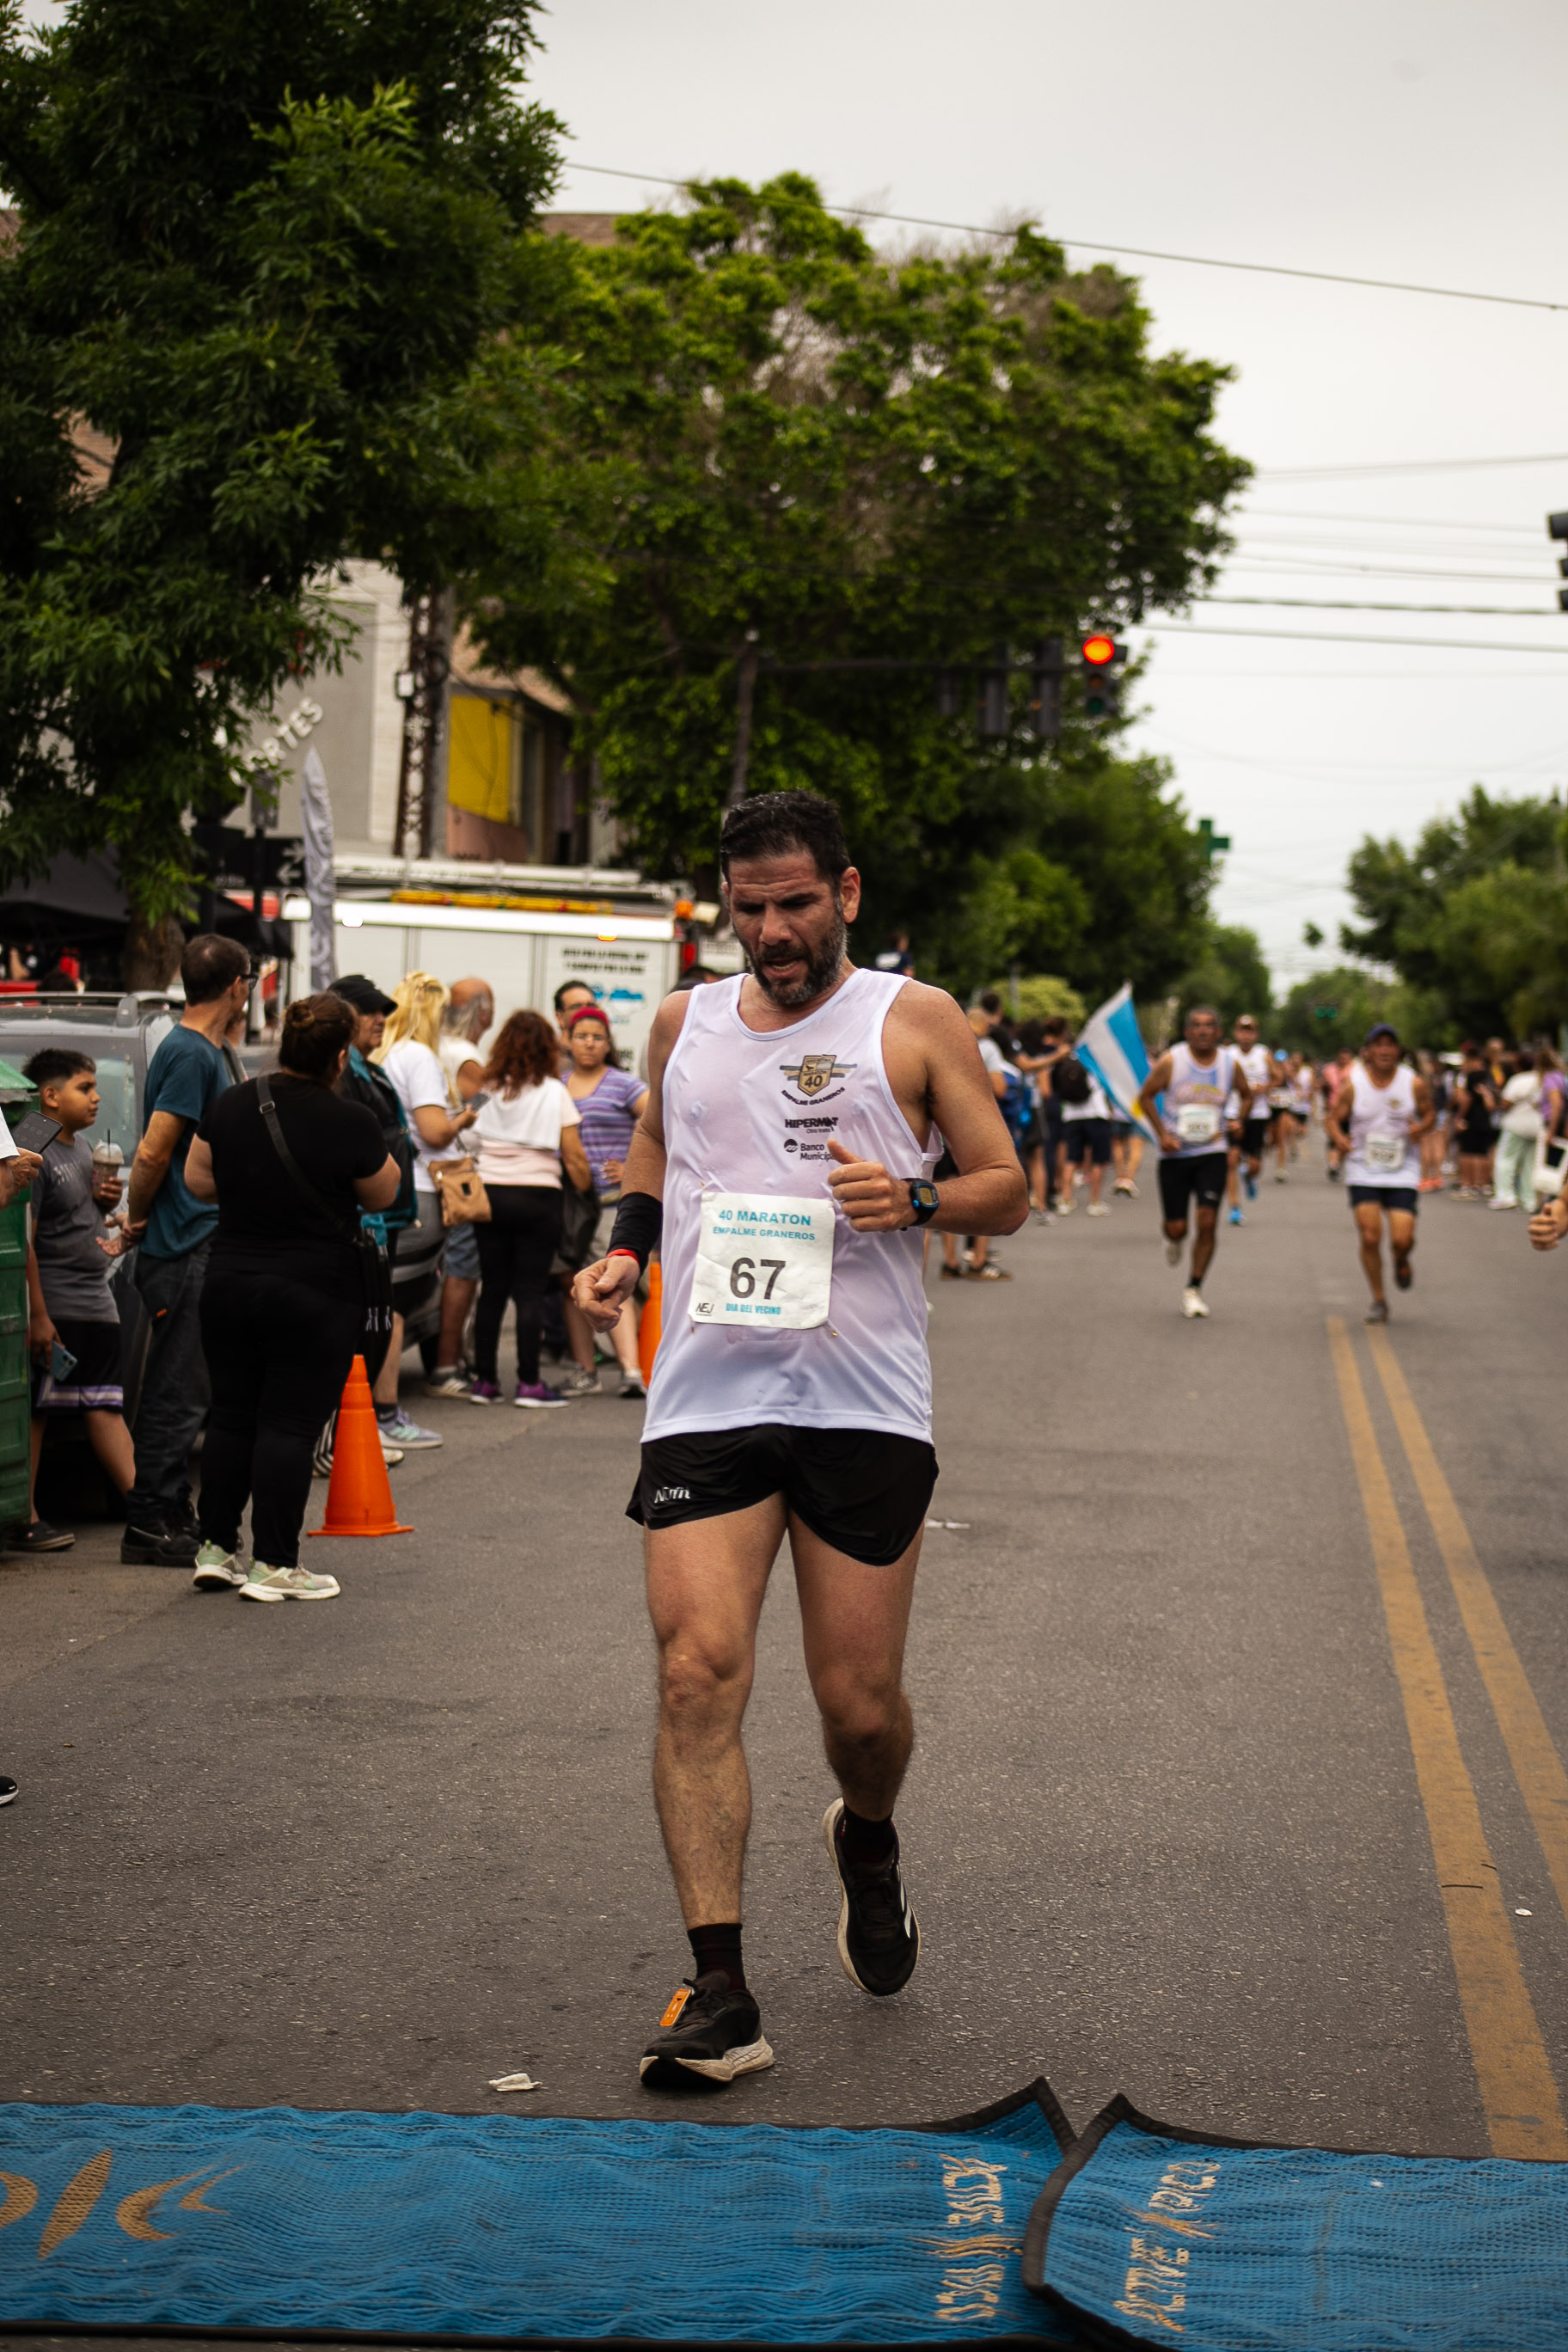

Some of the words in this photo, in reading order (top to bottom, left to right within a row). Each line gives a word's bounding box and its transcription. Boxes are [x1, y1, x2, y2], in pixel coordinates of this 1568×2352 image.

[804, 1075, 823, 1088] 40
[800, 1142, 824, 1151] Banco
[719, 1210, 733, 1221] 40
[737, 1210, 812, 1226] MARATON
[713, 1226, 756, 1236] EMPALME
[759, 1229, 816, 1240] GRANEROS
[730, 1257, 786, 1300] 67
[726, 1303, 738, 1312] DIA
[740, 1304, 753, 1314] DEL
[756, 1305, 781, 1315] VECINO
